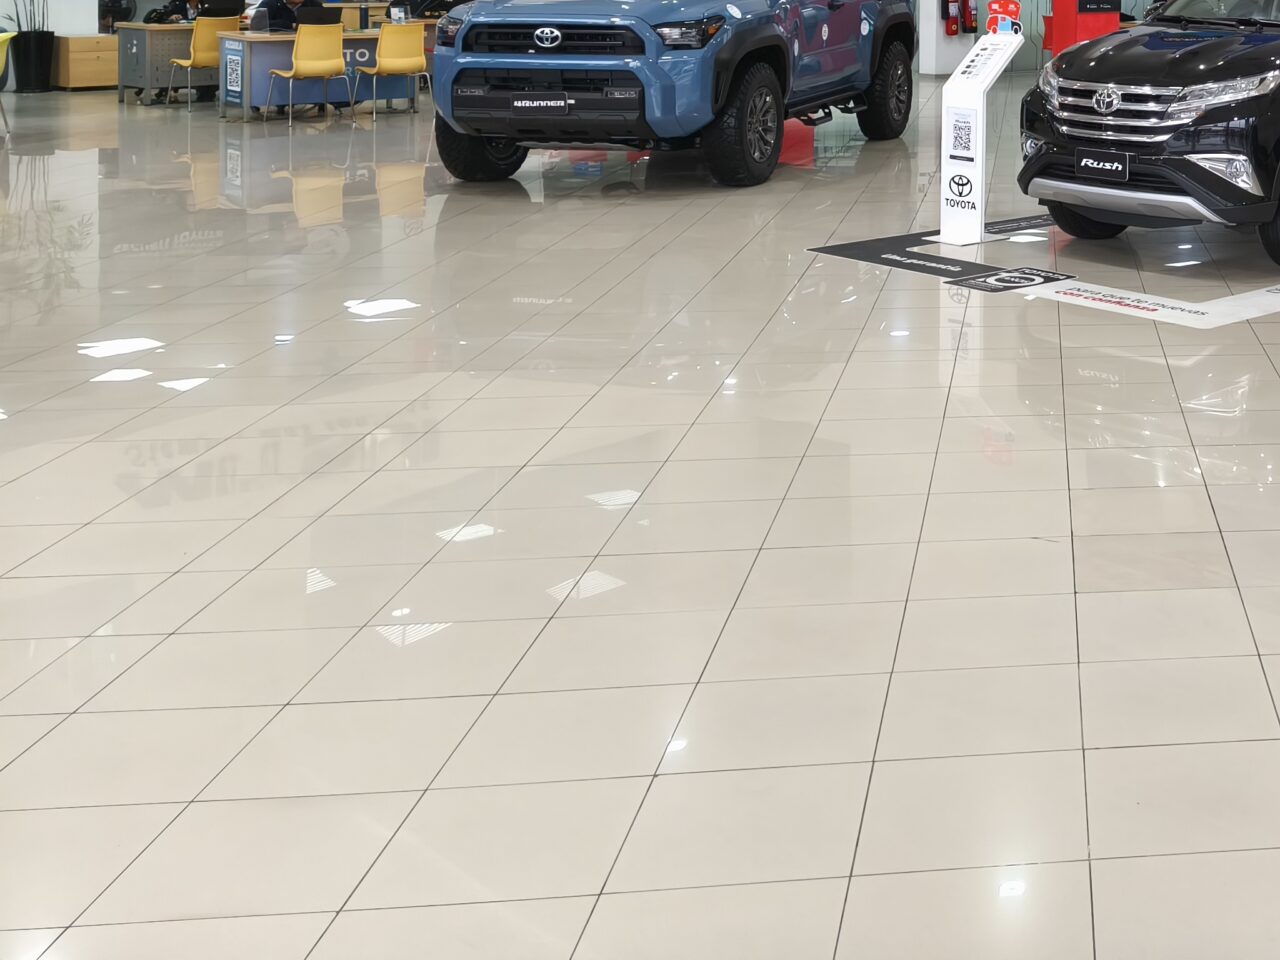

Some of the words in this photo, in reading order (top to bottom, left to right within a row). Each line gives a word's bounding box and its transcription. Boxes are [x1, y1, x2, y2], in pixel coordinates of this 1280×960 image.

[1080, 158, 1123, 172] Rush
[944, 197, 977, 211] TOYOTA
[1018, 267, 1068, 280] TOYOTA
[1054, 290, 1083, 299] con
[1102, 293, 1130, 302] que
[1149, 301, 1209, 316] muevas
